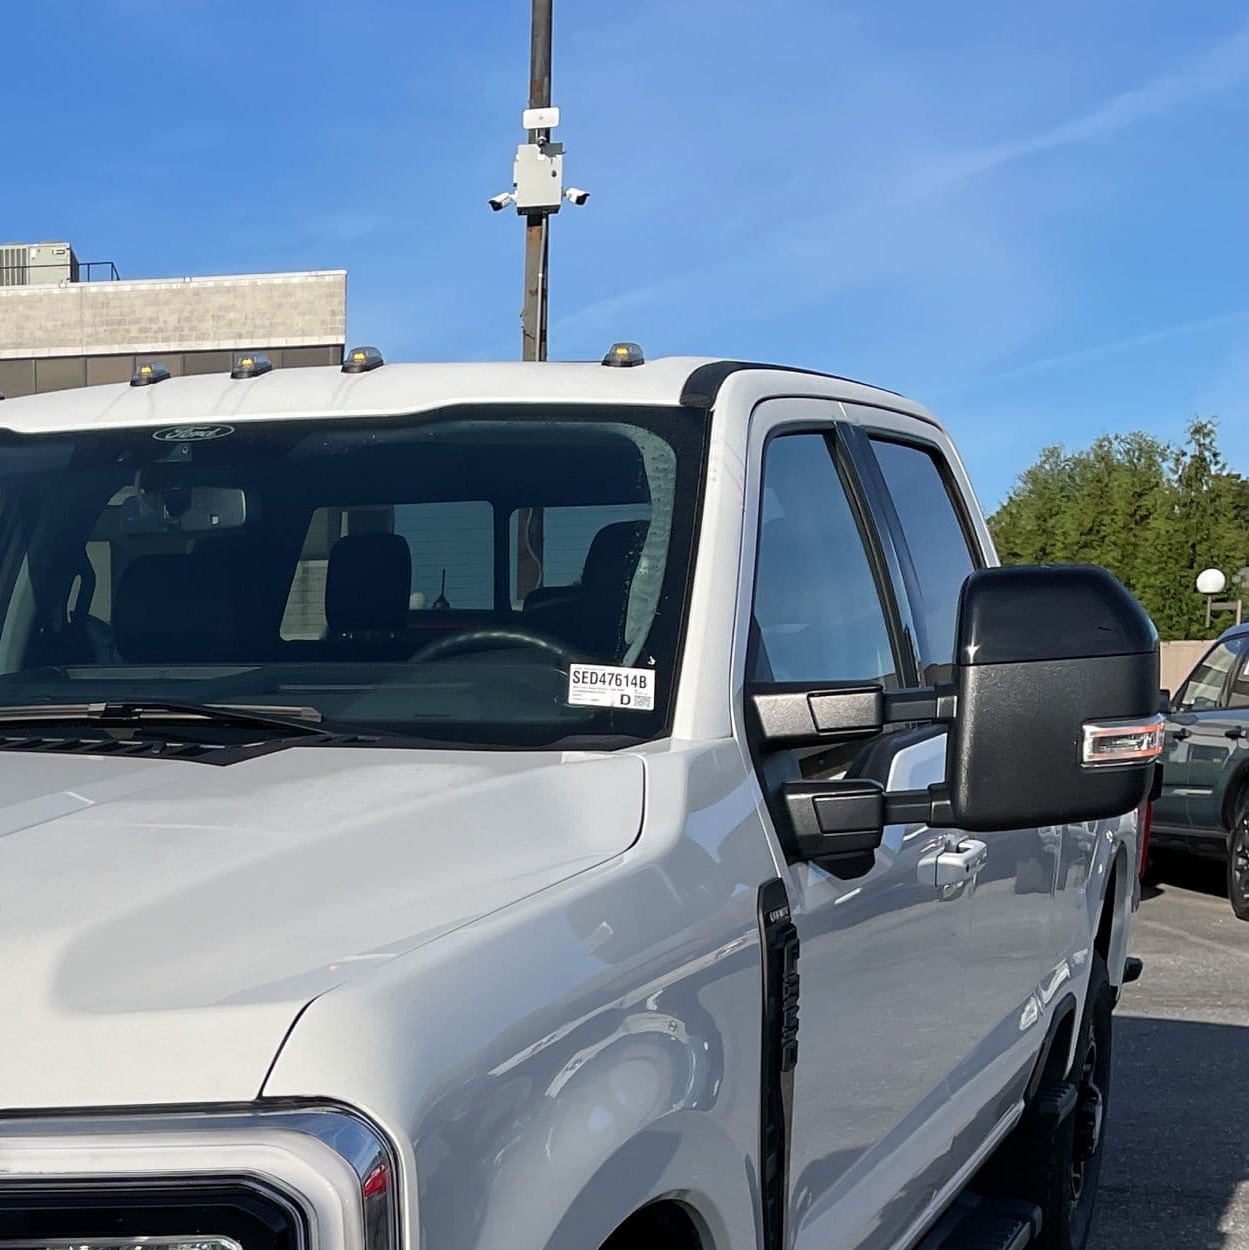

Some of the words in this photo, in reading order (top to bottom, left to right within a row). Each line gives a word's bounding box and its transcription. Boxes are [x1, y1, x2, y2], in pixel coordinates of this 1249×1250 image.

[165, 425, 222, 439] Ford
[572, 670, 647, 689] SED47614B
[620, 693, 631, 706] D
